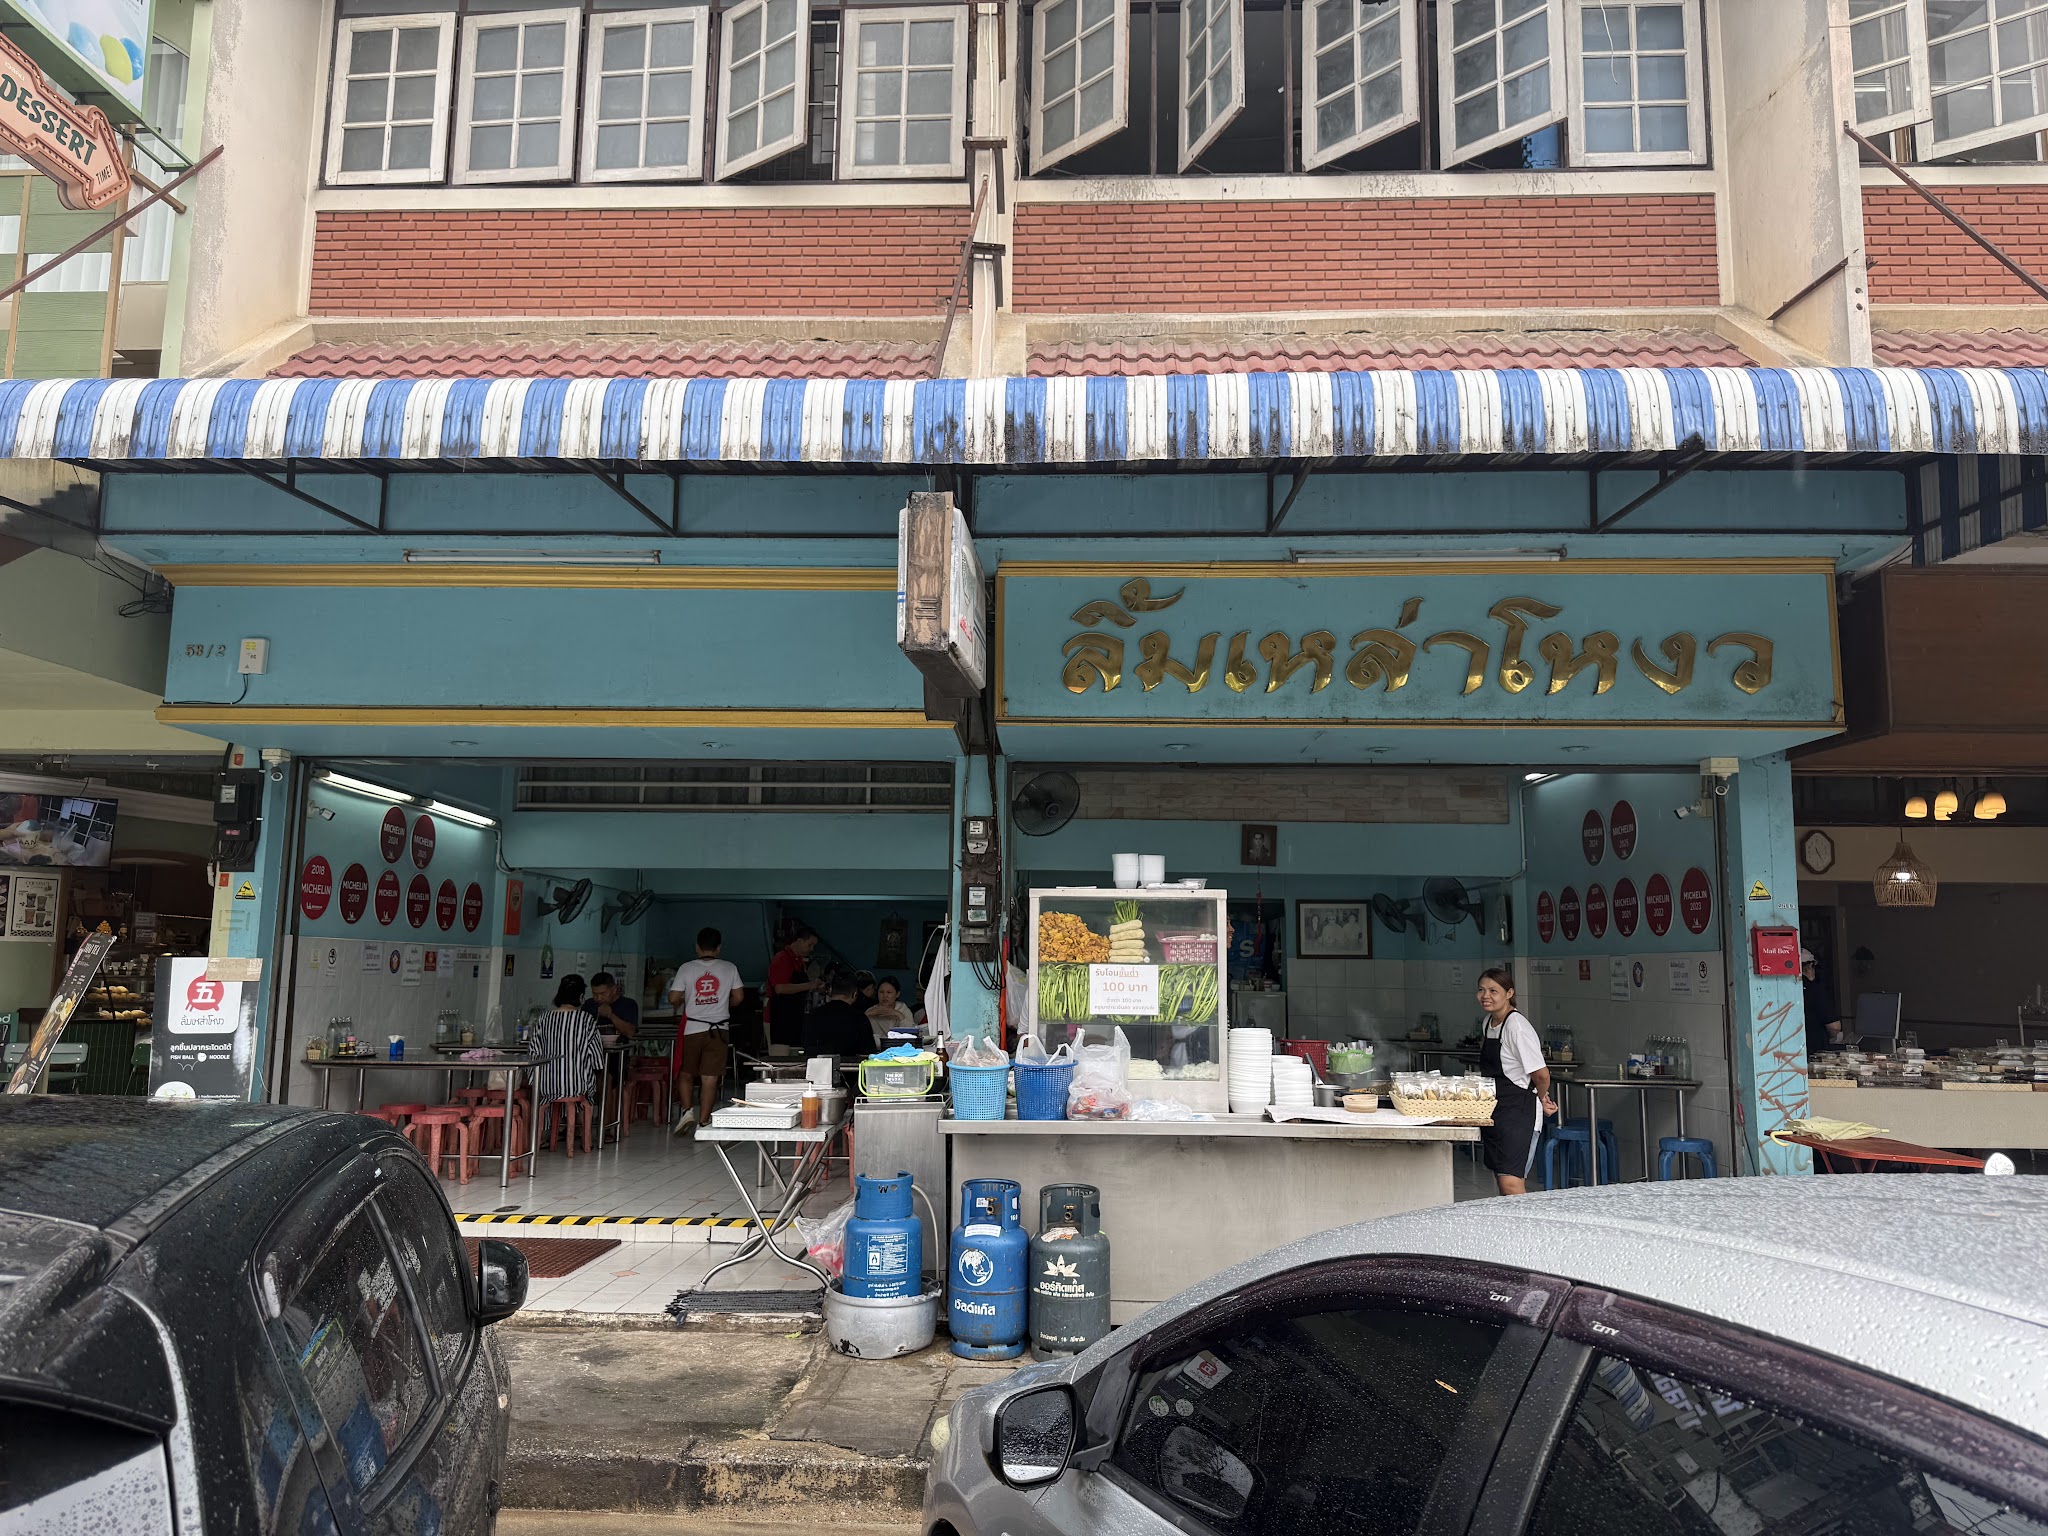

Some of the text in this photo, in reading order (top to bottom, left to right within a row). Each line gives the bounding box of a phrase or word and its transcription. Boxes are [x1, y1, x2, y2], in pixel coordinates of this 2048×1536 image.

[0, 74, 97, 166] DESSERT
[95, 164, 113, 185] TIME!
[1061, 577, 1773, 695] ลิ้มเหล่าโหงว
[383, 822, 405, 836] MICHELIN
[1583, 827, 1603, 837] MICHELIN
[1612, 823, 1634, 836] MICHELIN
[413, 834, 434, 848] MICHELIN
[311, 864, 325, 875] 2018
[301, 882, 332, 895] MICHELIN
[342, 880, 368, 891] MICHELIN
[378, 888, 398, 897] MICHELIN
[409, 891, 430, 901] MICHELIN
[1683, 889, 1708, 901] MICHELIN
[1614, 896, 1637, 908] MICHELIN
[1646, 893, 1670, 905] MICHELIN
[1559, 902, 1580, 911] MICHELIN
[1587, 900, 1606, 911] MICHELIN
[1689, 901, 1702, 911] 2023
[699, 979, 715, 993] 五
[1103, 982, 1125, 991] 100
[191, 982, 217, 1004] 五
[1490, 1292, 1513, 1303] CITY
[1593, 1323, 1620, 1336] CITY
